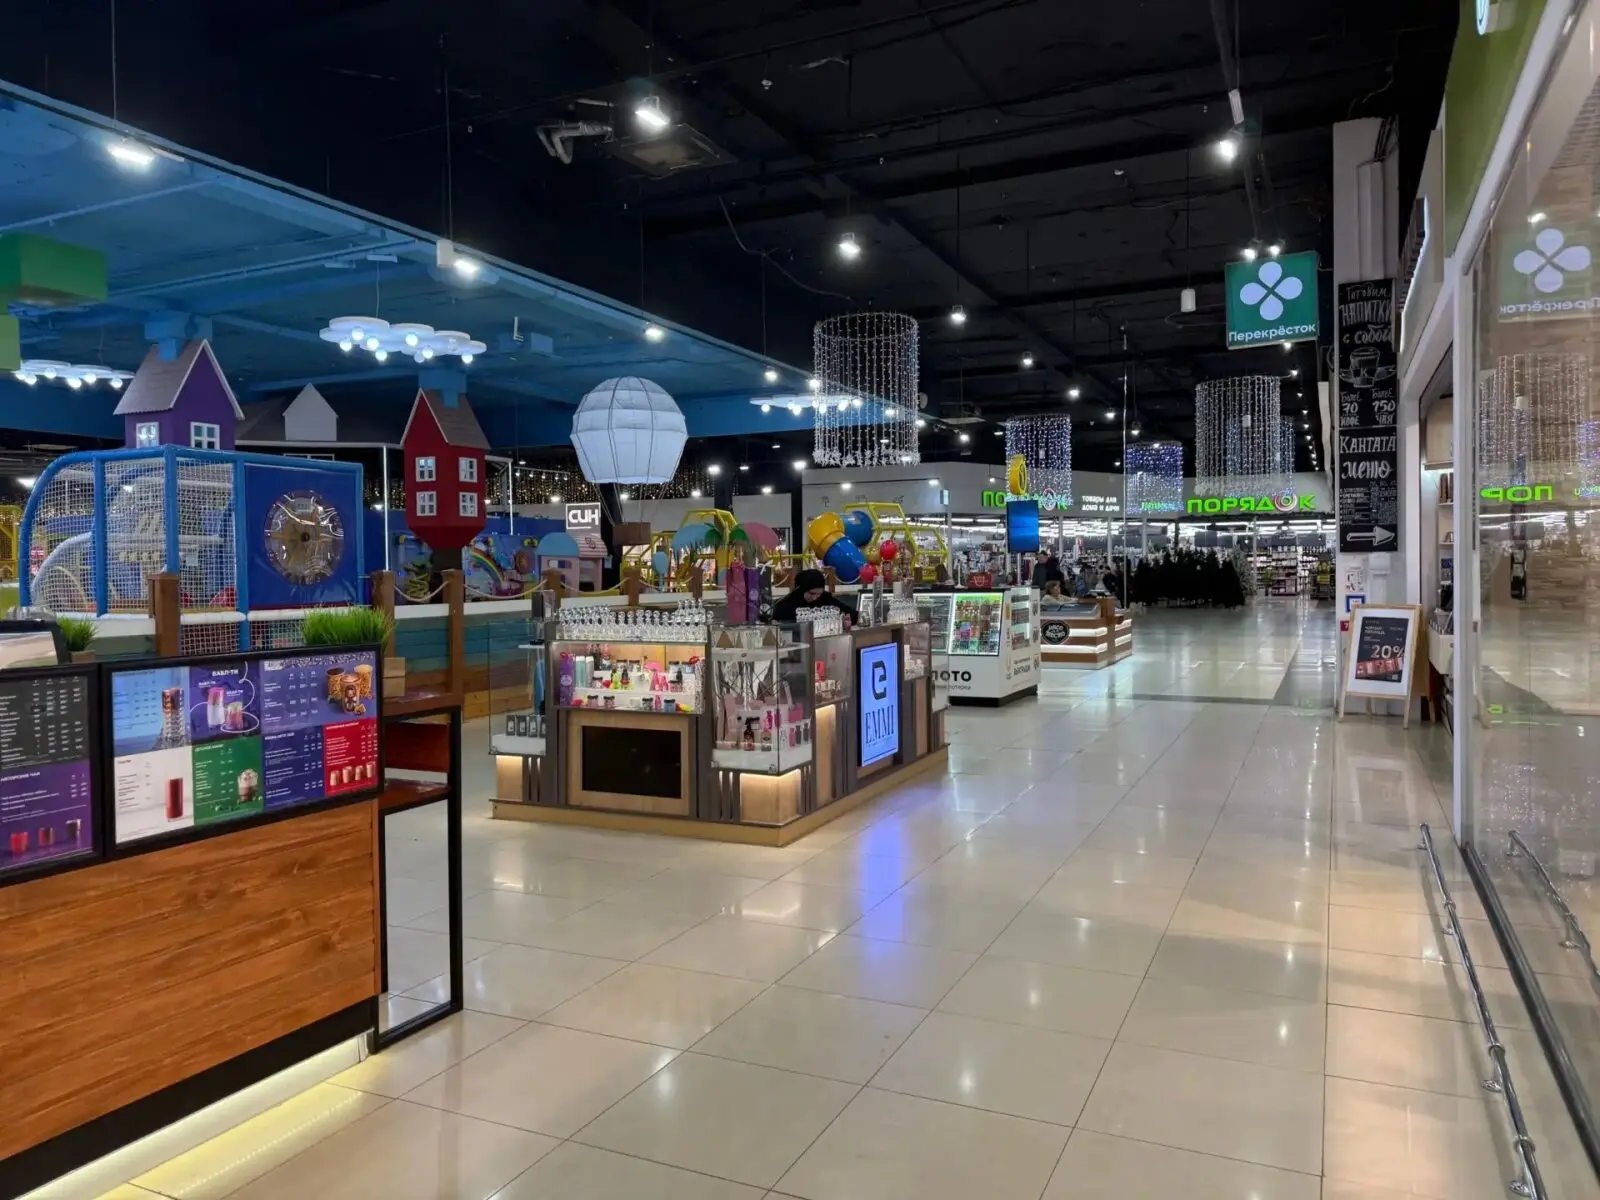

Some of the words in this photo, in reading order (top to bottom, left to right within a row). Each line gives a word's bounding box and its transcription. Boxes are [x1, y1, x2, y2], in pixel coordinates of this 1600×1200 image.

[1228, 323, 1316, 342] Перекрёсток
[1341, 402, 1359, 413] 70
[1340, 436, 1397, 454] КАНТАТА
[1187, 494, 1316, 513] ПОРЯДОК
[1371, 644, 1404, 659] 20%
[865, 705, 894, 744] EMMI
